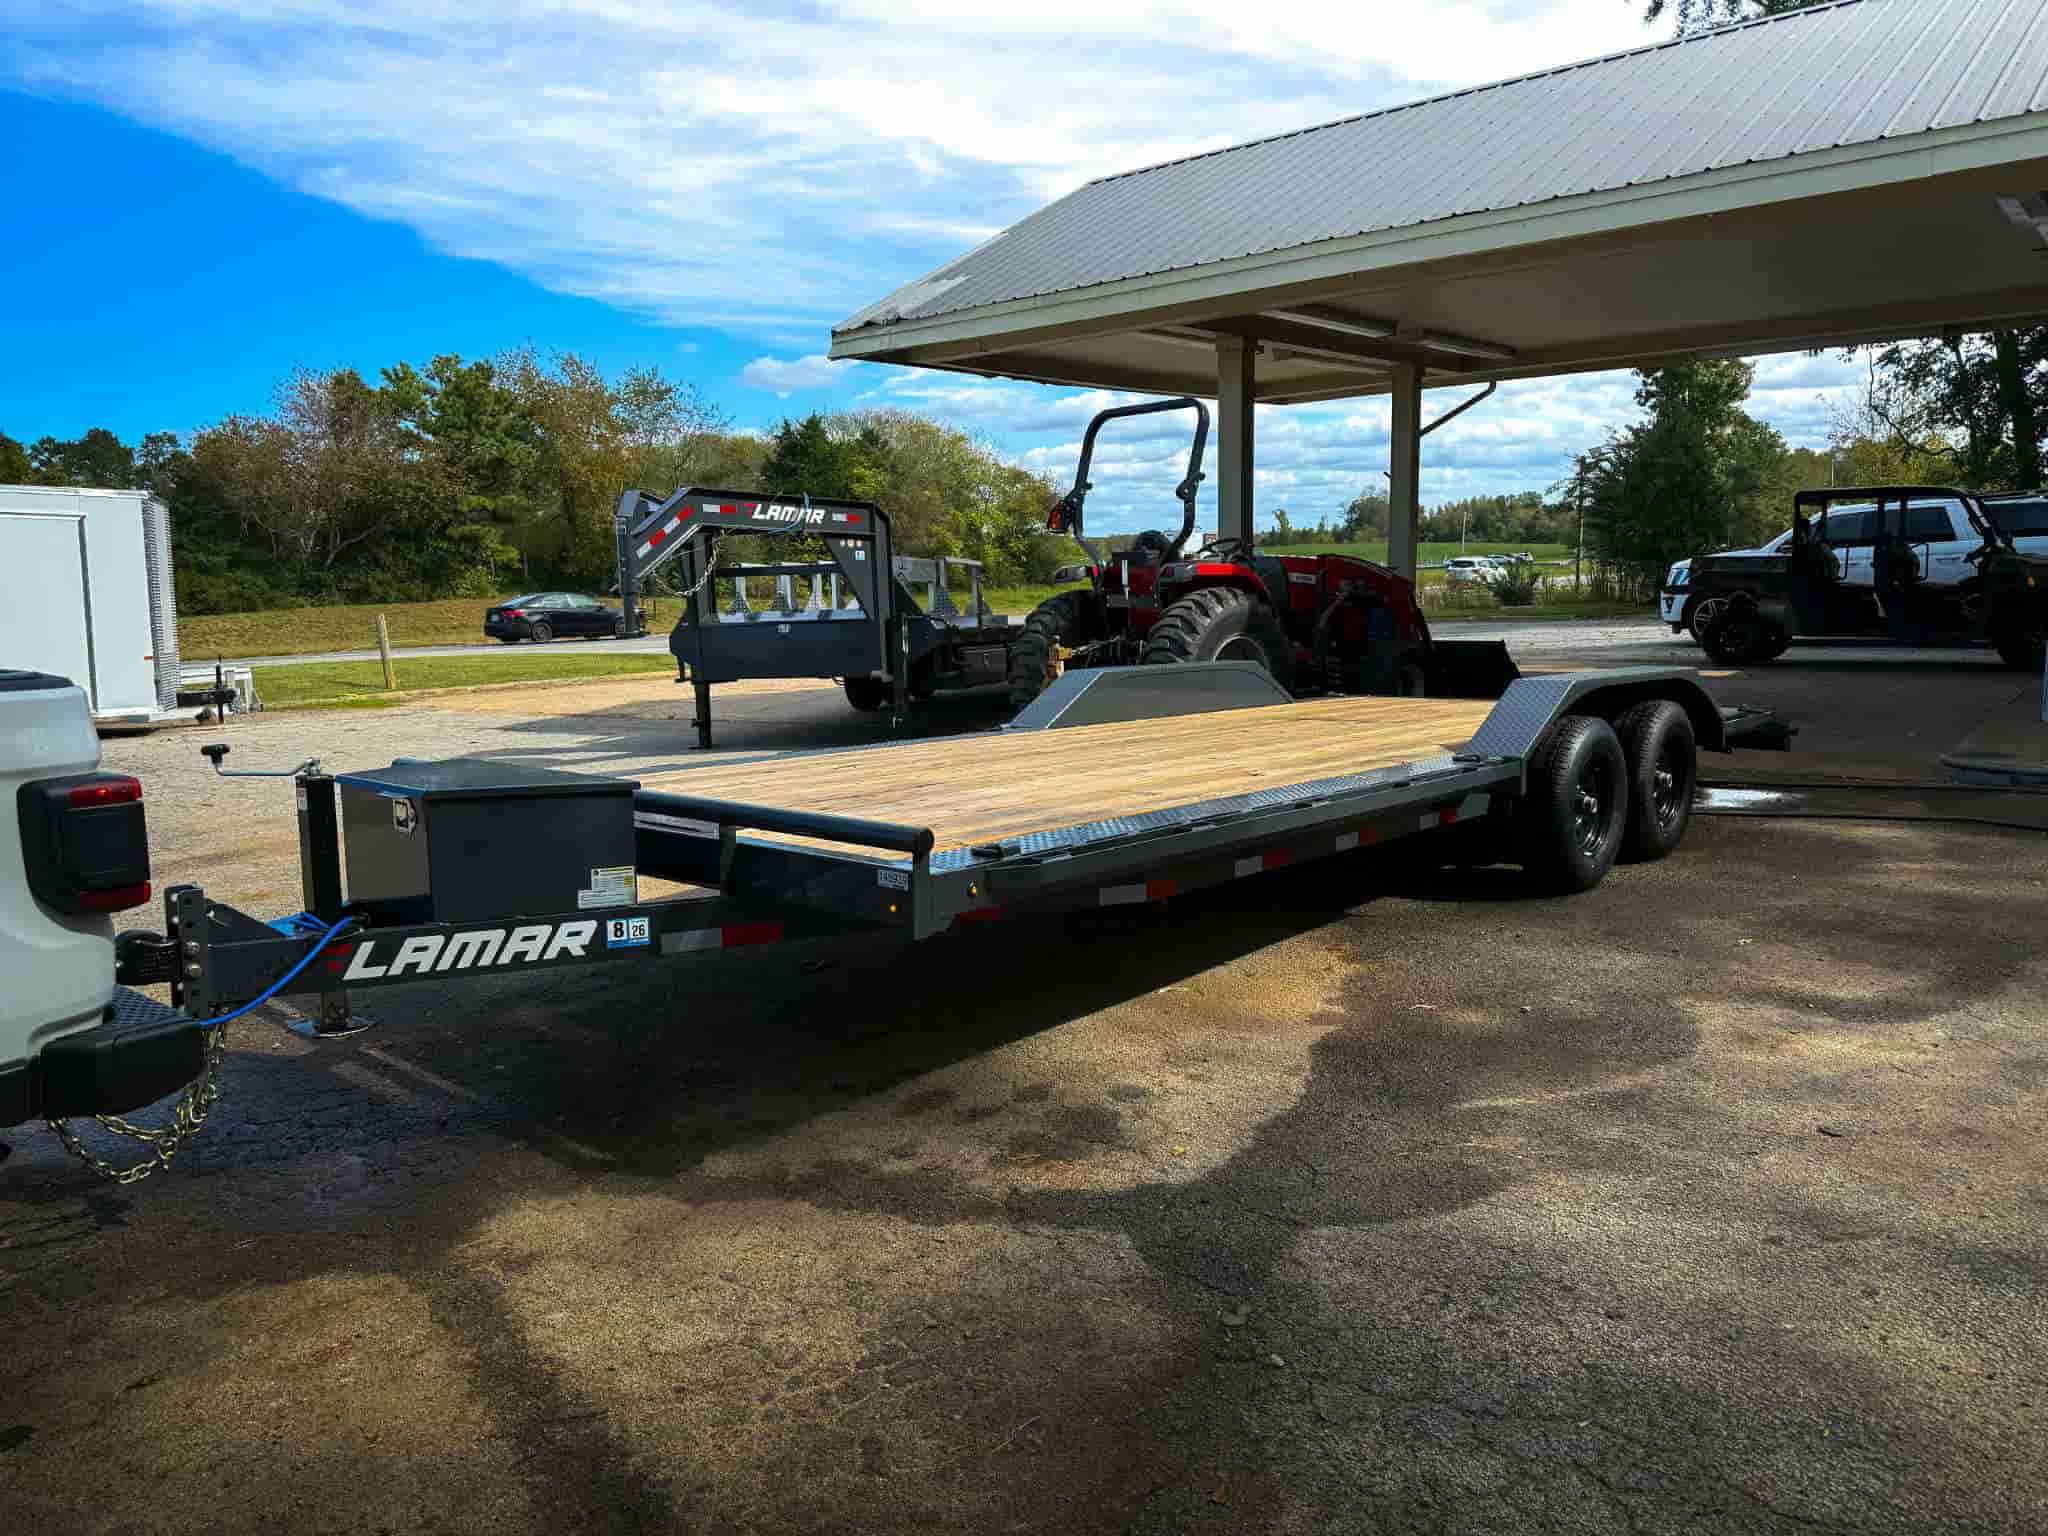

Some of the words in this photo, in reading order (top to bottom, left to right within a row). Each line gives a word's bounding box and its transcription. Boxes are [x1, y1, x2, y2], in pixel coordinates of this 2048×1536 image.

[752, 503, 825, 524] LAMAR
[613, 921, 625, 938] 8
[631, 924, 646, 937] 26
[342, 920, 598, 980] LAMAR
